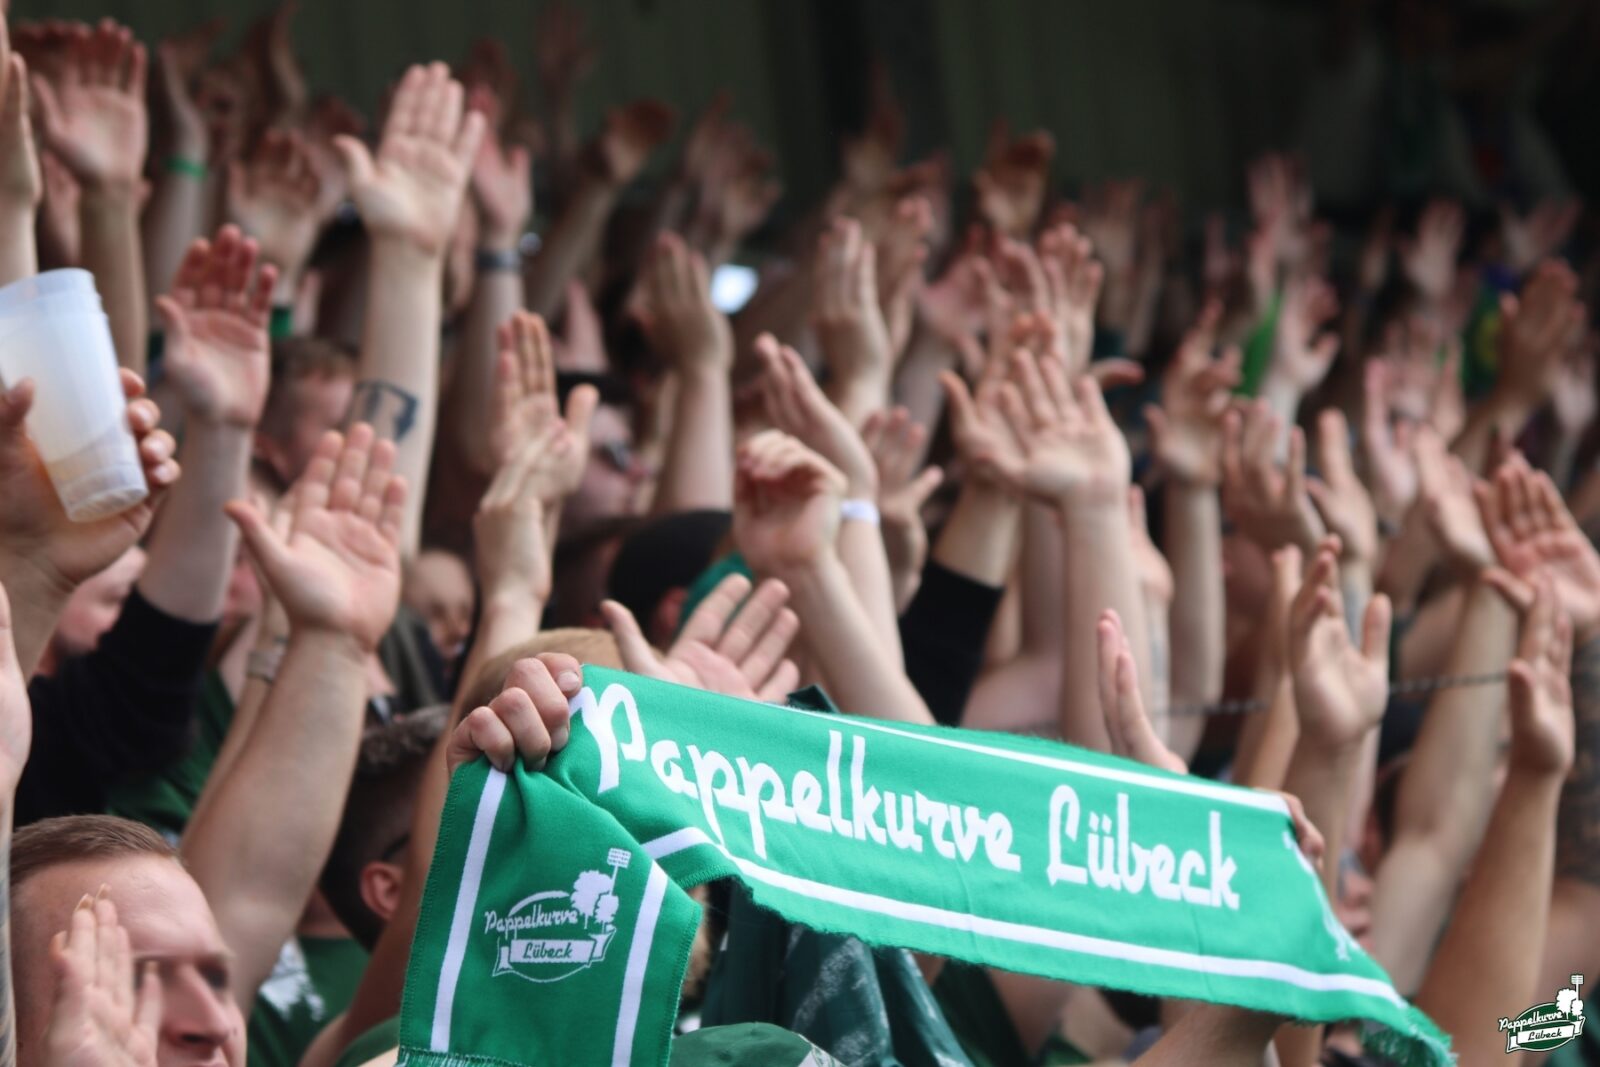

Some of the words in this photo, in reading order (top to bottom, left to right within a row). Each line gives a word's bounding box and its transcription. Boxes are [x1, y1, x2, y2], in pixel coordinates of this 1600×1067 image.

[568, 682, 1021, 872] Pappelkurve
[1047, 783, 1240, 910] Lübeck
[484, 904, 579, 940] Pappelkurve
[522, 942, 573, 959] Lübeck
